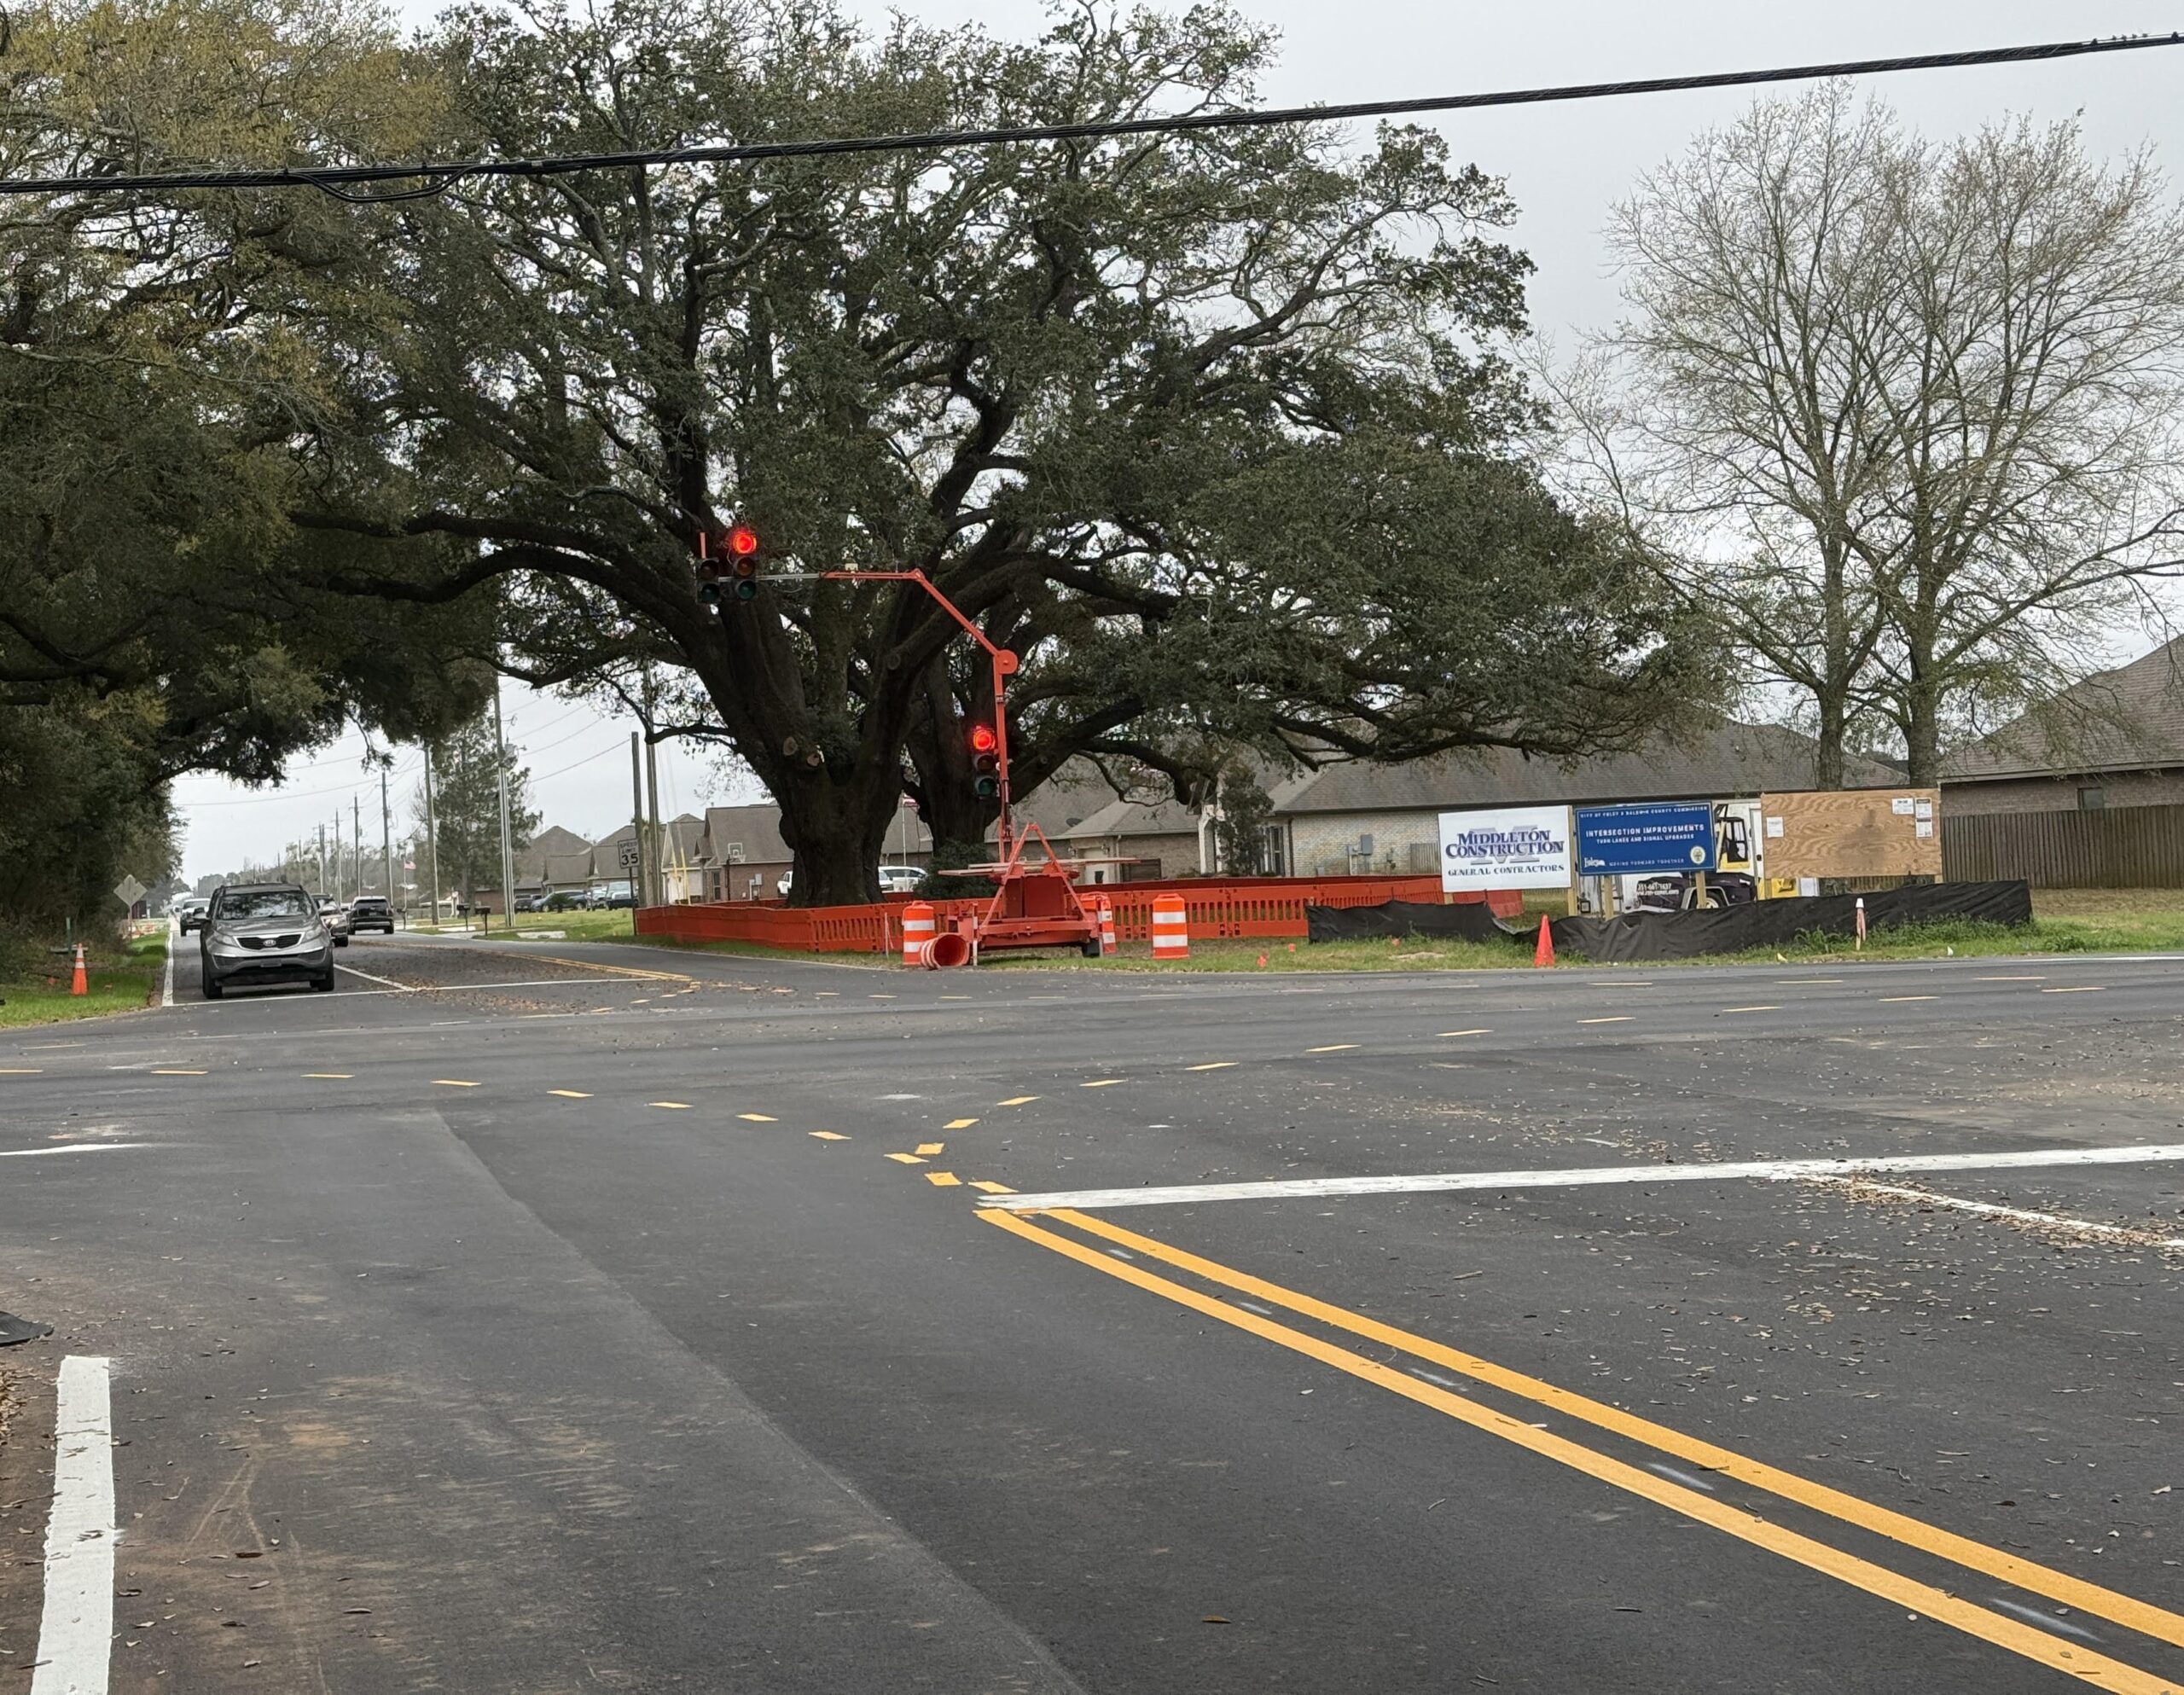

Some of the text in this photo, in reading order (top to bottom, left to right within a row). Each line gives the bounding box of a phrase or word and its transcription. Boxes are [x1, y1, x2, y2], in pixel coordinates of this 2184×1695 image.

[1457, 829, 1550, 845] MIDDLETON
[1586, 824, 1705, 837] INTERSECTION IMPROVEMENTS
[1445, 841, 1565, 859] CONSTRUCTION
[621, 853, 638, 865] 35
[1448, 864, 1565, 877] GENERAL CONTRACTORS
